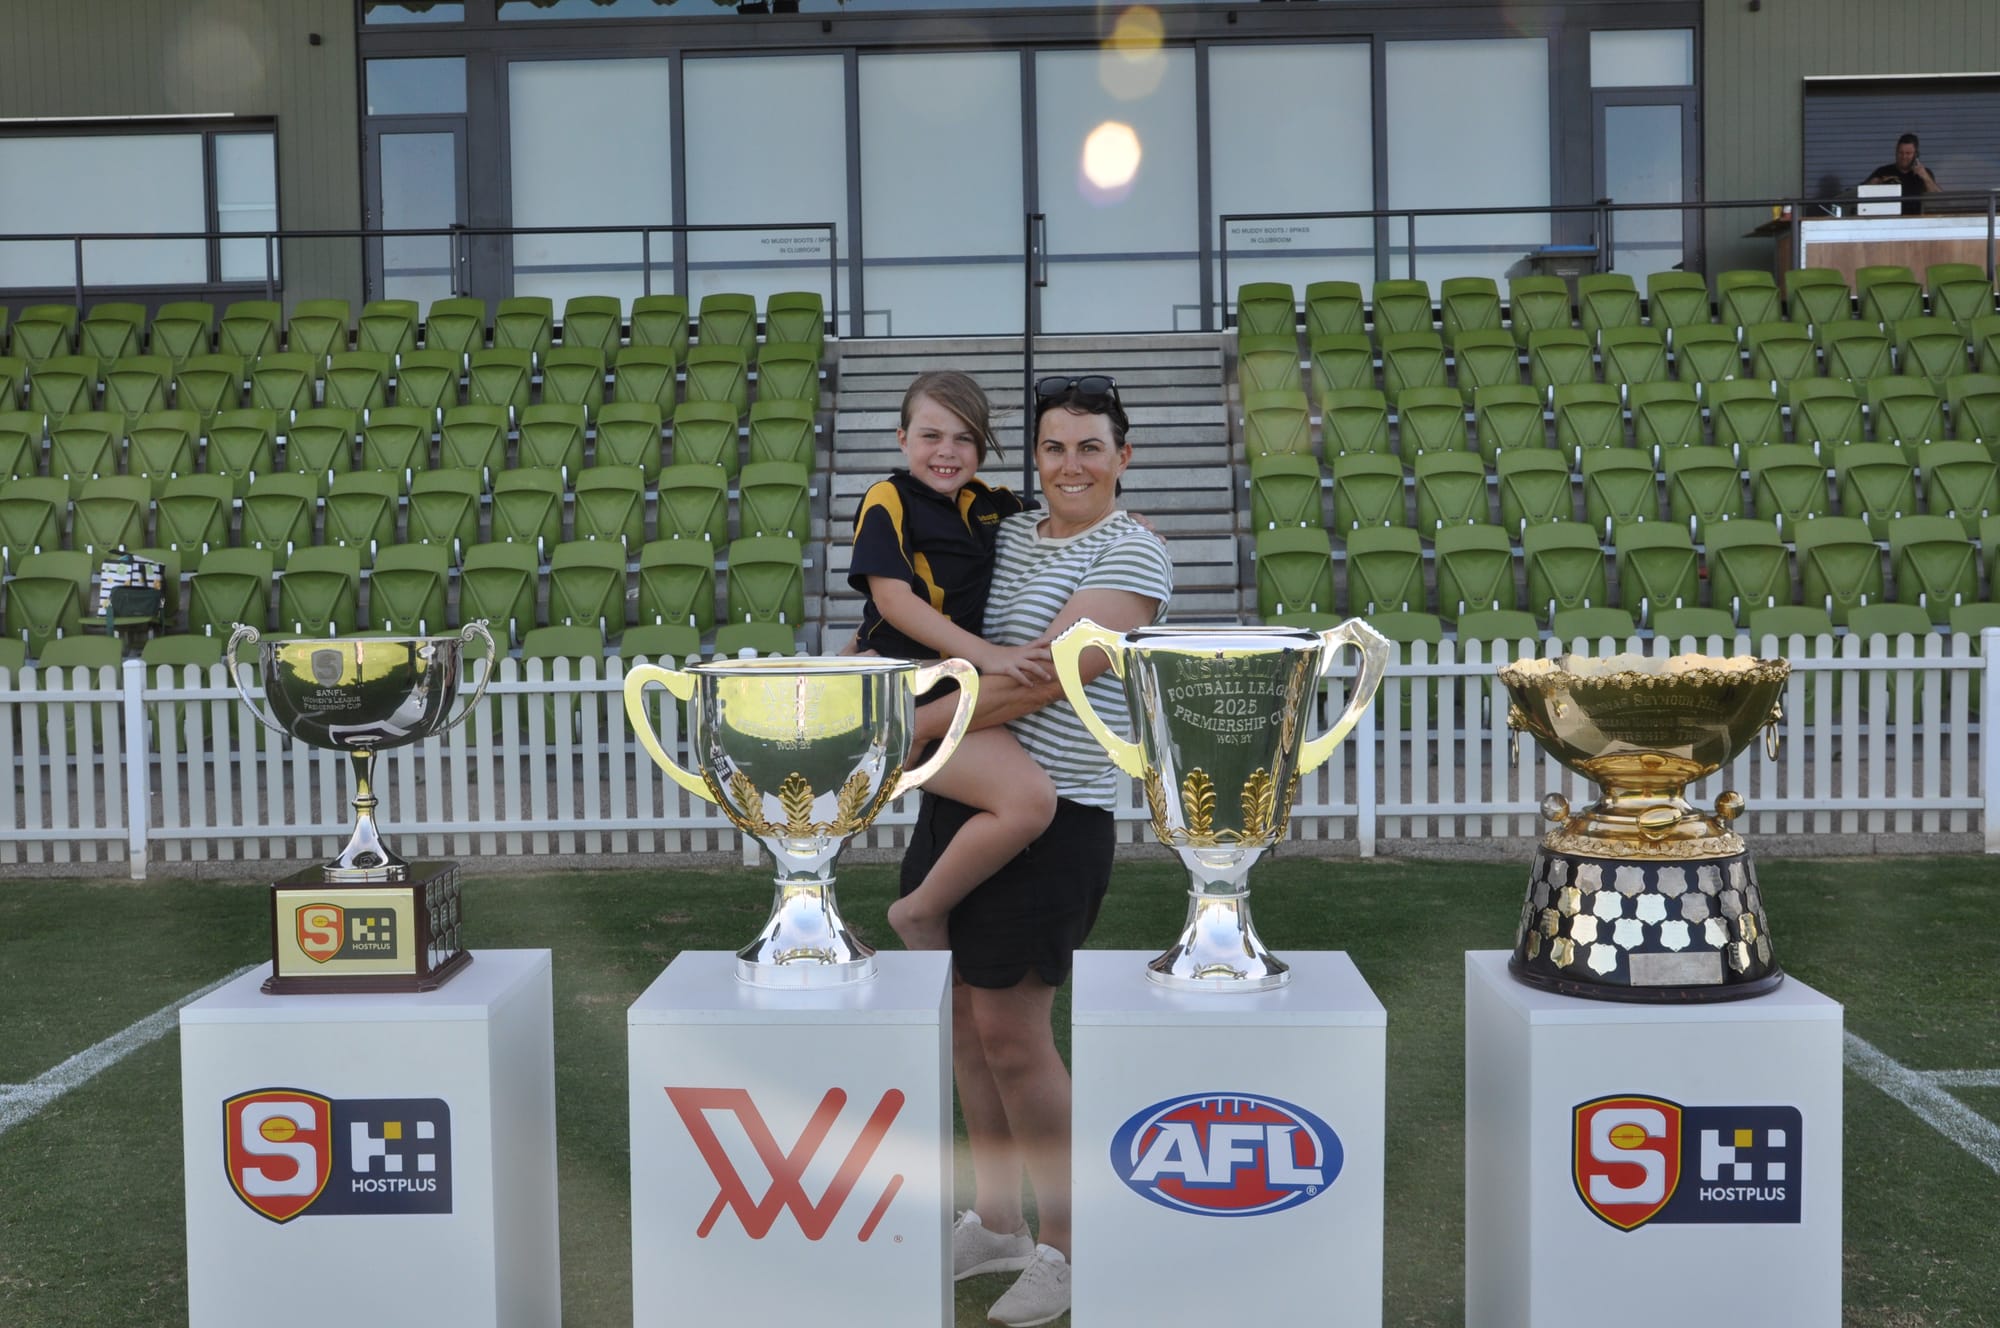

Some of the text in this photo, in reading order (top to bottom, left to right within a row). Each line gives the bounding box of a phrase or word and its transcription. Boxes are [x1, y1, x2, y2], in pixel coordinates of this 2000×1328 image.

[1241, 226, 1263, 234] MUDDY
[1264, 226, 1284, 234] BOOTS
[316, 689, 347, 697] SANFL
[1167, 680, 1298, 702] FOOTBALL LEAGU
[334, 696, 361, 704] LEAGUE
[1213, 698, 1258, 716] 2025
[1173, 703, 1297, 733] PREMIERSHIP CU
[1216, 734, 1253, 746] WON BY
[241, 1101, 317, 1197] S
[1129, 1122, 1325, 1185] AFL
[1589, 1108, 1667, 1205] S
[352, 1178, 437, 1192] HOSTPLUS
[1699, 1187, 1786, 1201] HOSTPLUS
